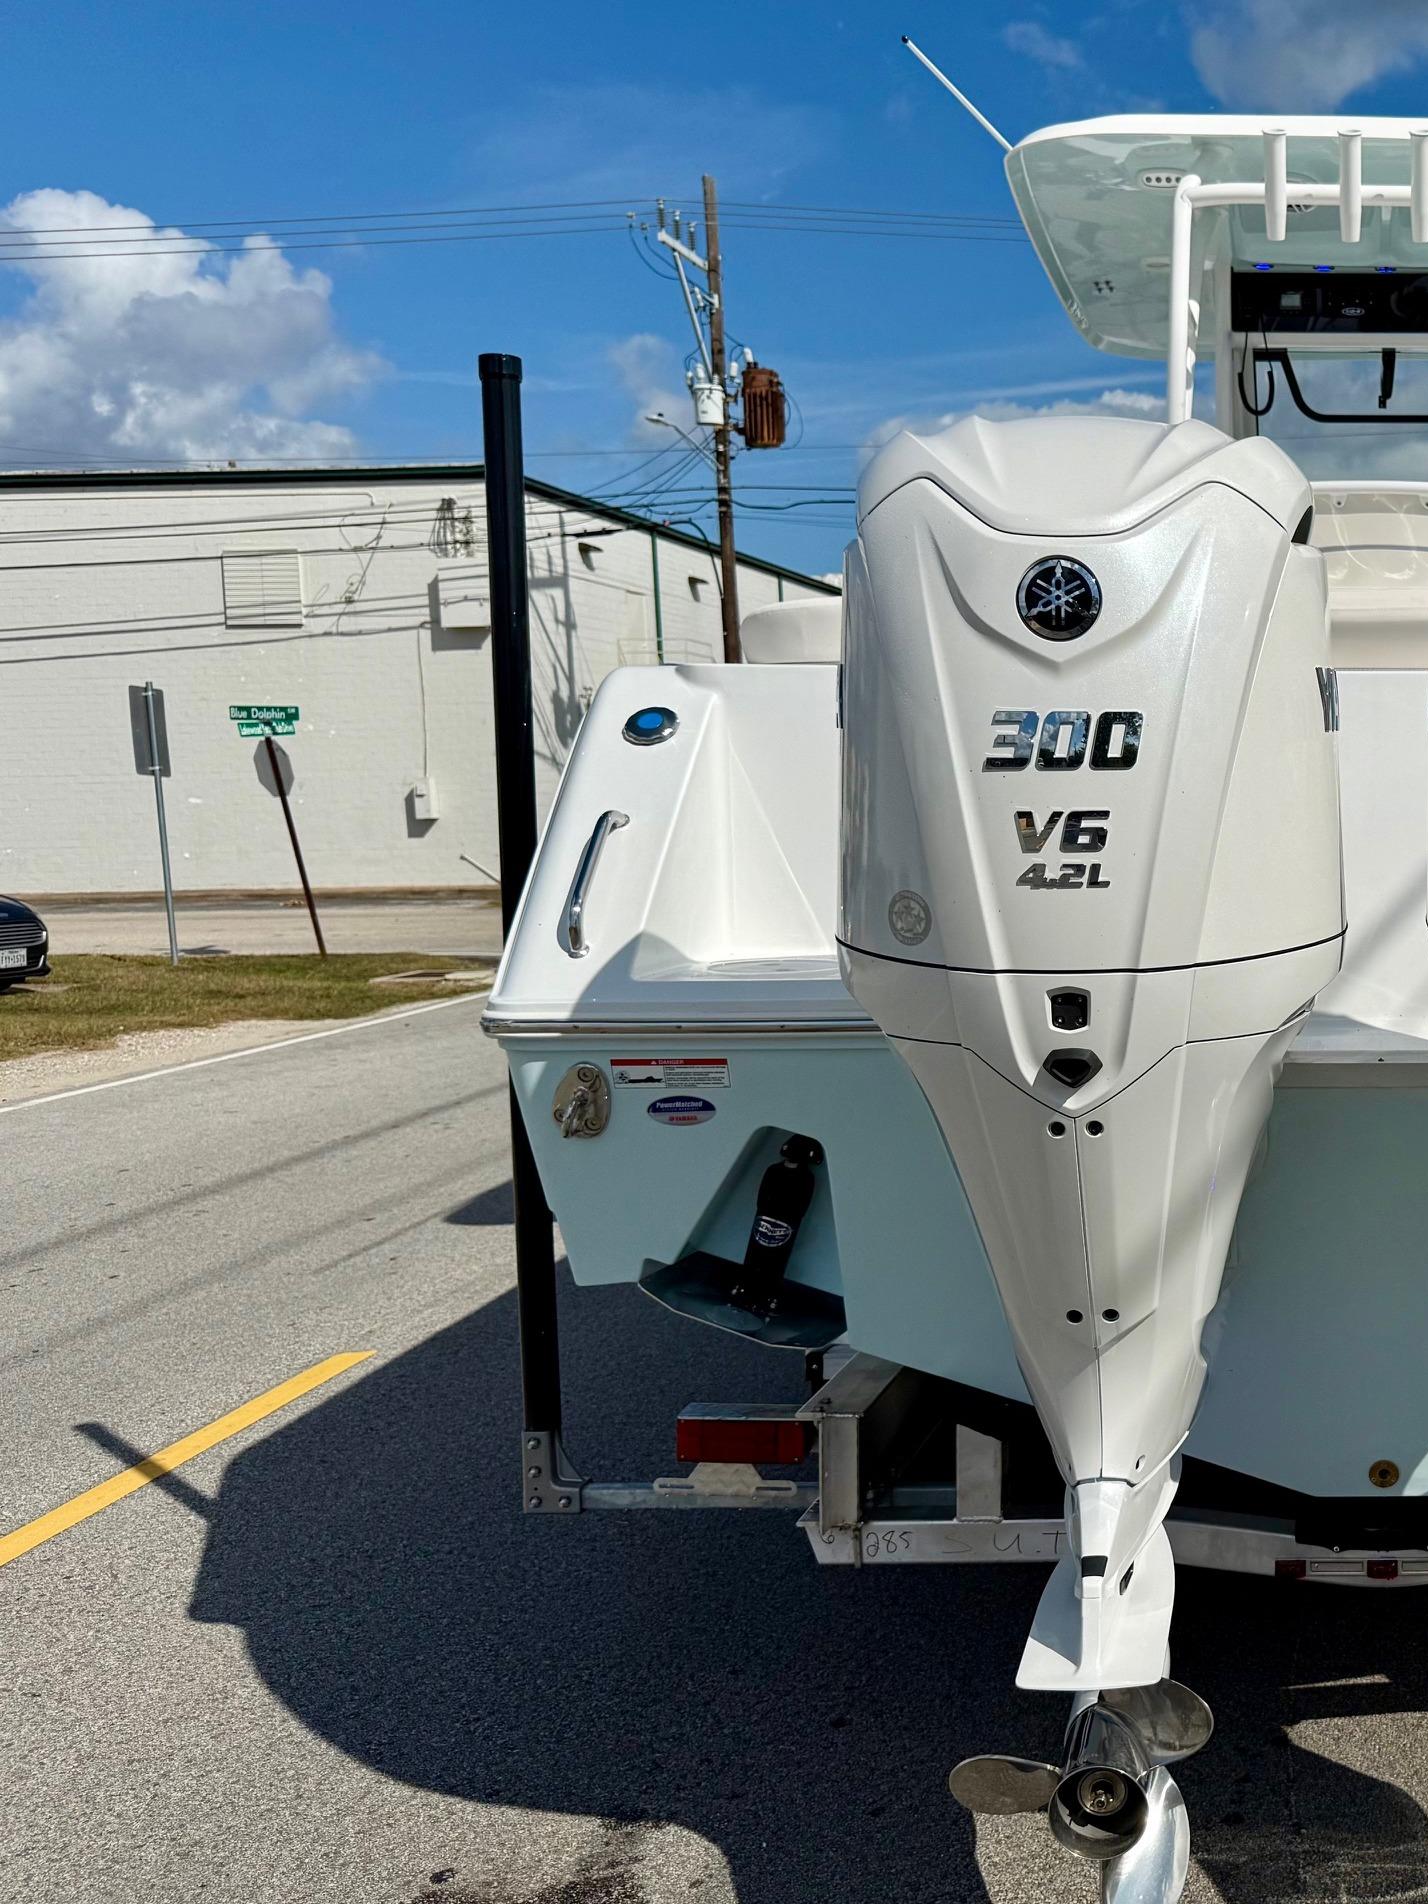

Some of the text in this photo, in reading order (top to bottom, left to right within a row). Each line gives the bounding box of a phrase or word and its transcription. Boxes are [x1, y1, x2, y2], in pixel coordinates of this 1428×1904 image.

[230, 707, 248, 719] Blue
[251, 707, 286, 719] Dolphin
[981, 710, 1144, 773] 300
[1013, 810, 1111, 854] V6
[1015, 862, 1111, 890] 4.2L
[656, 1101, 703, 1109] PowerMatched
[865, 1530, 913, 1557] 285
